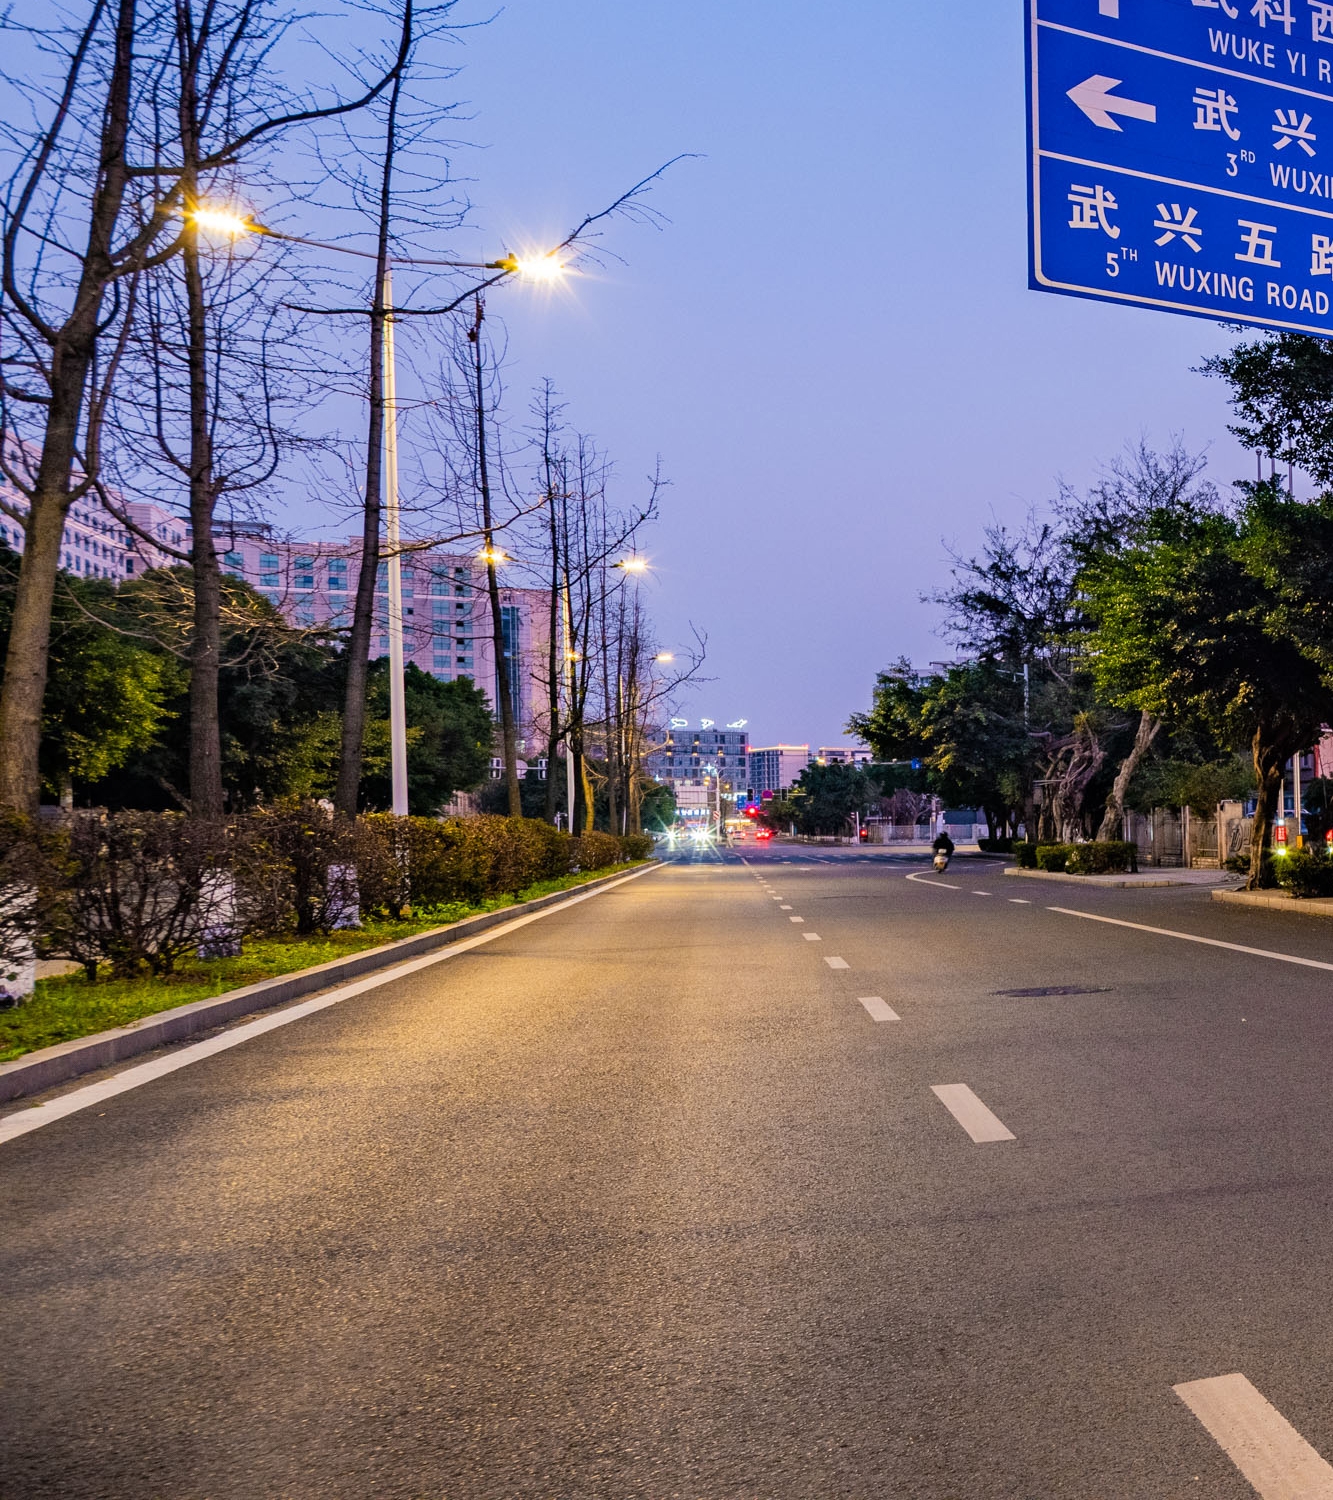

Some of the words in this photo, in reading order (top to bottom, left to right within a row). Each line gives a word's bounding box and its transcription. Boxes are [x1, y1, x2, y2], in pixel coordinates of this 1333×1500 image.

[1208, 27, 1275, 68] WUKE
[1286, 51, 1306, 77] YI
[1225, 148, 1256, 177] 3RD
[1105, 246, 1138, 278] 5TH
[1155, 260, 1254, 302] WUXING
[1266, 282, 1329, 315] ROAD
